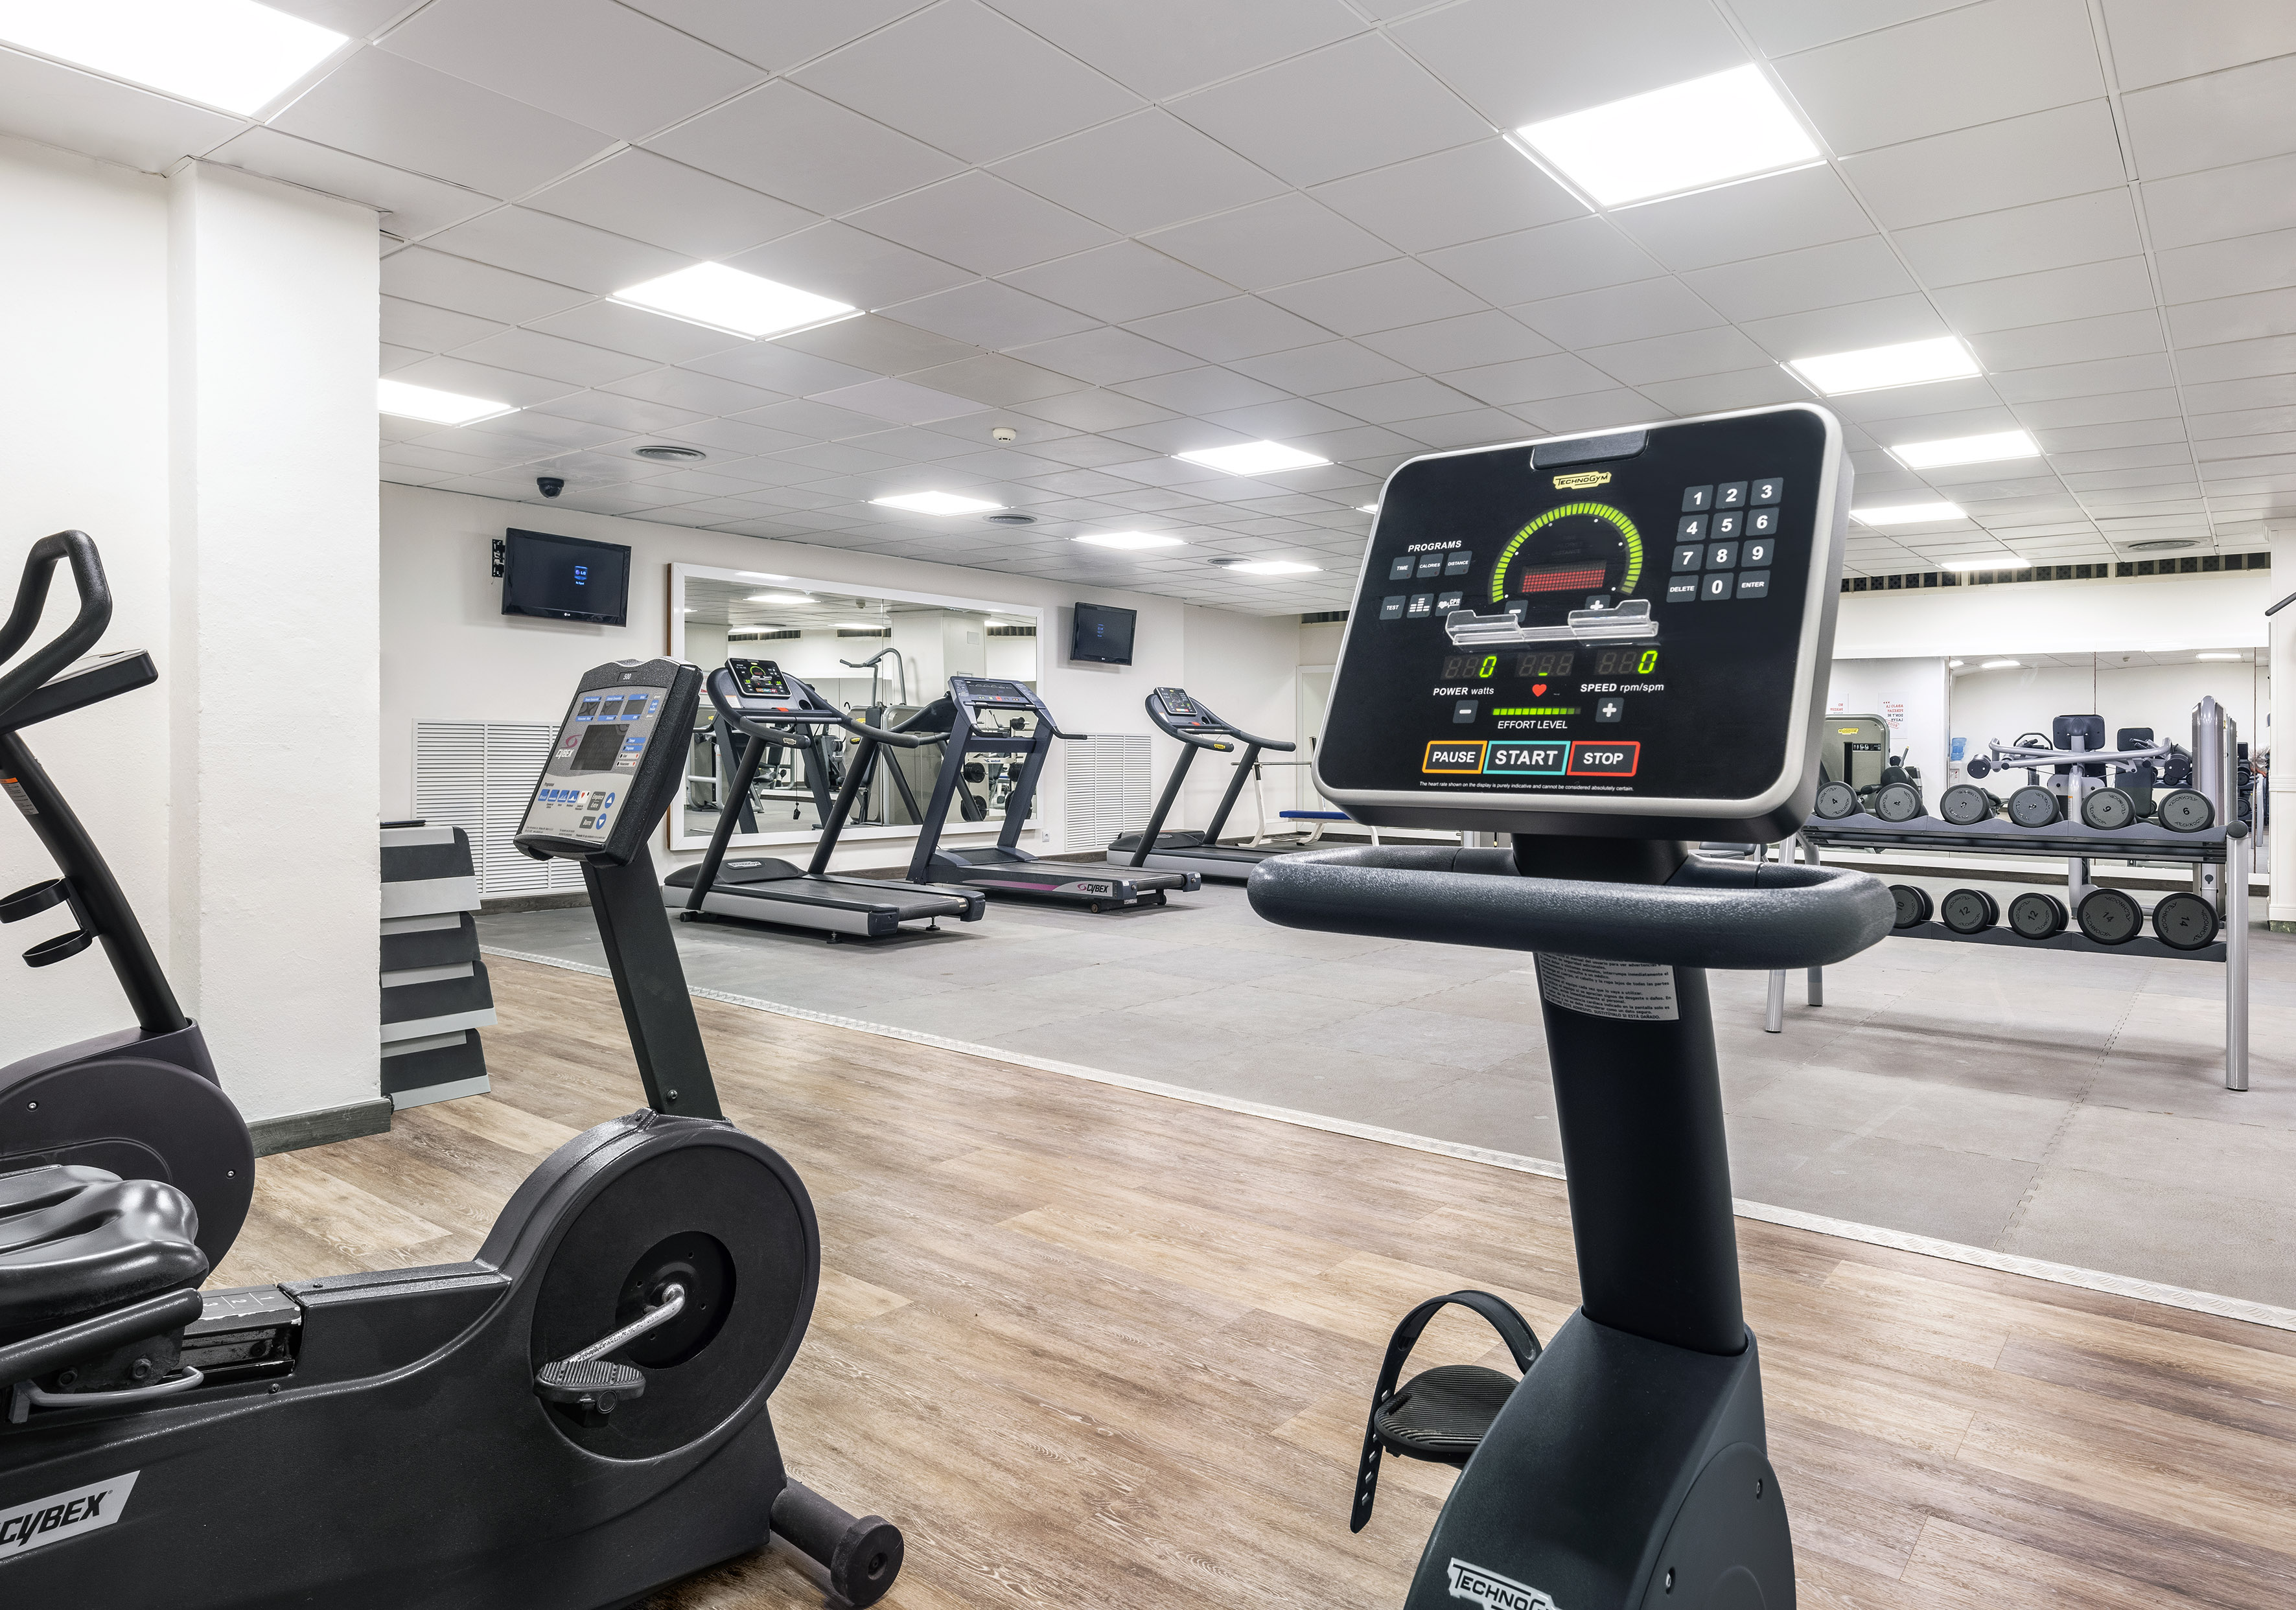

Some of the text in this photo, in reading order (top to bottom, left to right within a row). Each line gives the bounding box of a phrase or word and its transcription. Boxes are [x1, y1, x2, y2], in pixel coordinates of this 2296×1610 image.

[1725, 489, 1737, 502] 2
[1761, 485, 1772, 498] 3
[1693, 492, 1702, 505] 1
[1686, 522, 1698, 535] 4
[1721, 518, 1732, 532] 5
[1756, 515, 1768, 529] 6
[1408, 540, 1462, 552] PROGRAMS
[1682, 551, 1693, 565] 7
[1716, 549, 1728, 562] 8
[1752, 546, 1763, 560] 9
[1711, 580, 1722, 594] 0
[1479, 656, 1497, 678] 0
[1638, 650, 1658, 674] 0
[1433, 687, 1494, 696] POWER watts
[1581, 682, 1665, 693] SPEED rpm/spm
[1498, 720, 1568, 729] EFFORT LEVEL
[555, 748, 574, 760] CYBEX
[1432, 752, 1476, 763] PAUSE
[1495, 750, 1558, 765] START
[1583, 752, 1624, 765] STOP
[1086, 883, 1109, 893] CYBEX
[1959, 906, 1970, 916] 12
[2027, 910, 2039, 922] 12
[2104, 912, 2115, 923] 14
[2179, 916, 2190, 927] 14
[0, 1491, 109, 1548] CYBEX
